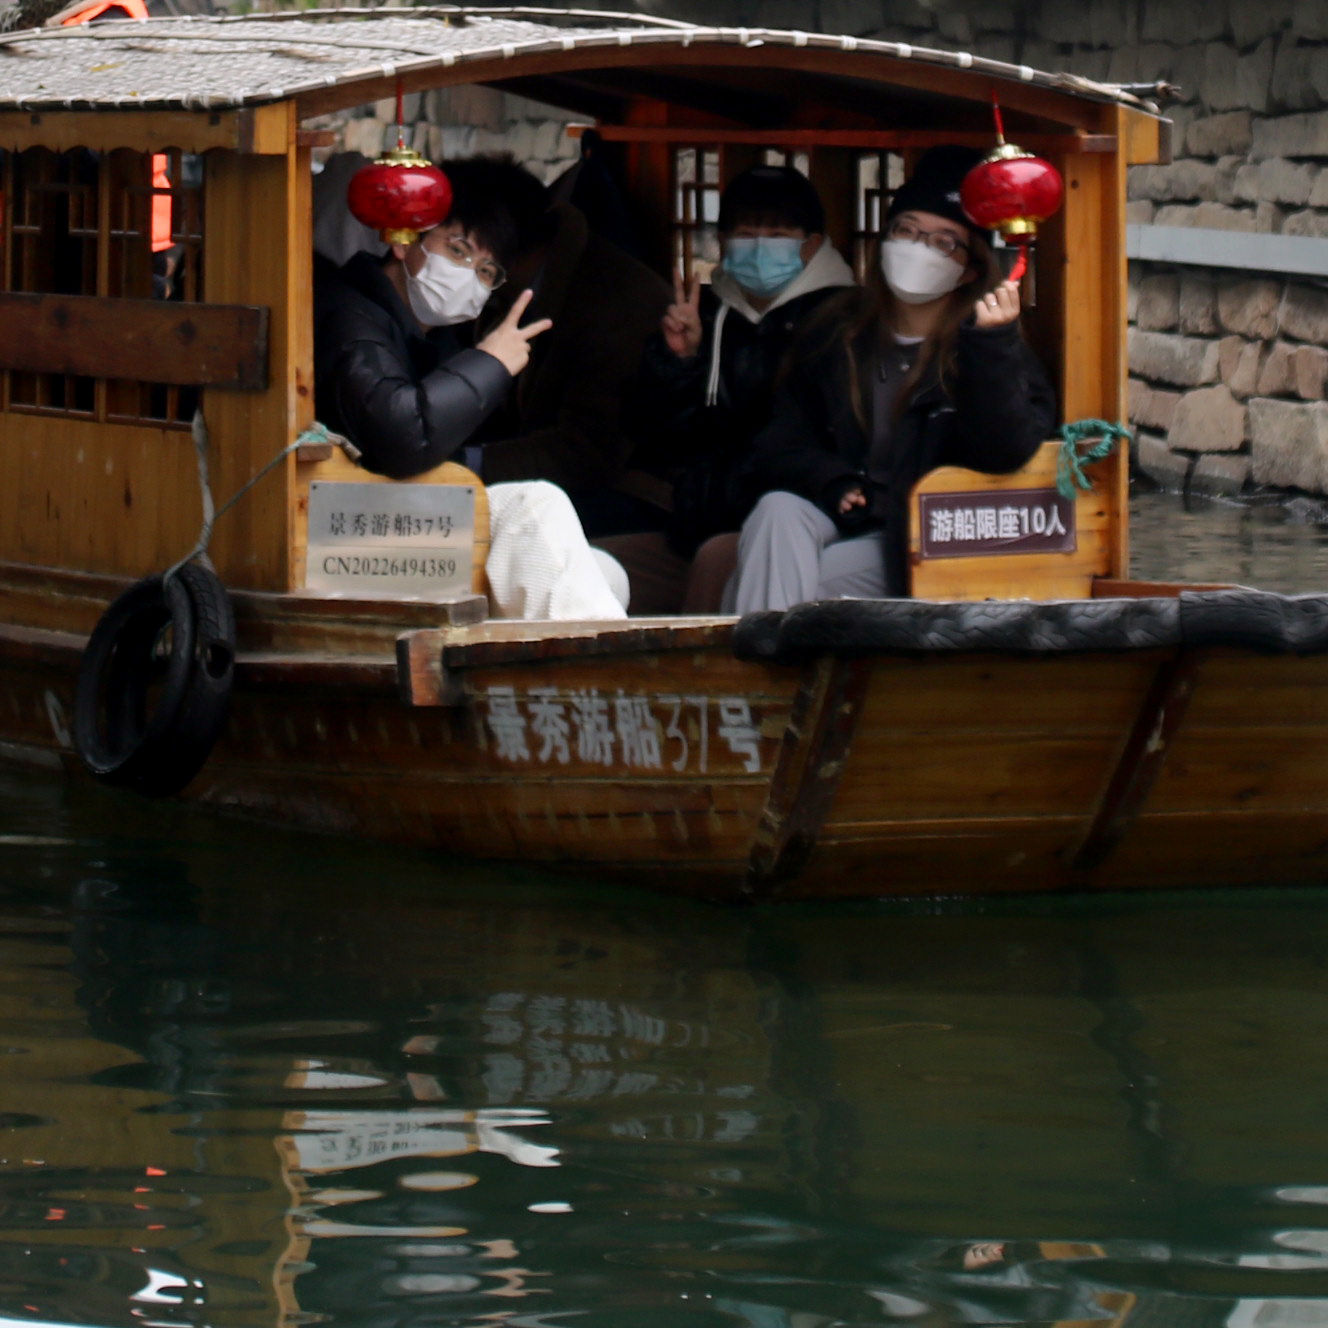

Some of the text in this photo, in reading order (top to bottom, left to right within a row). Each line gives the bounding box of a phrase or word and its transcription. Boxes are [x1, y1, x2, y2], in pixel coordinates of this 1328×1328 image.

[930, 504, 1067, 543] 游船限座10人
